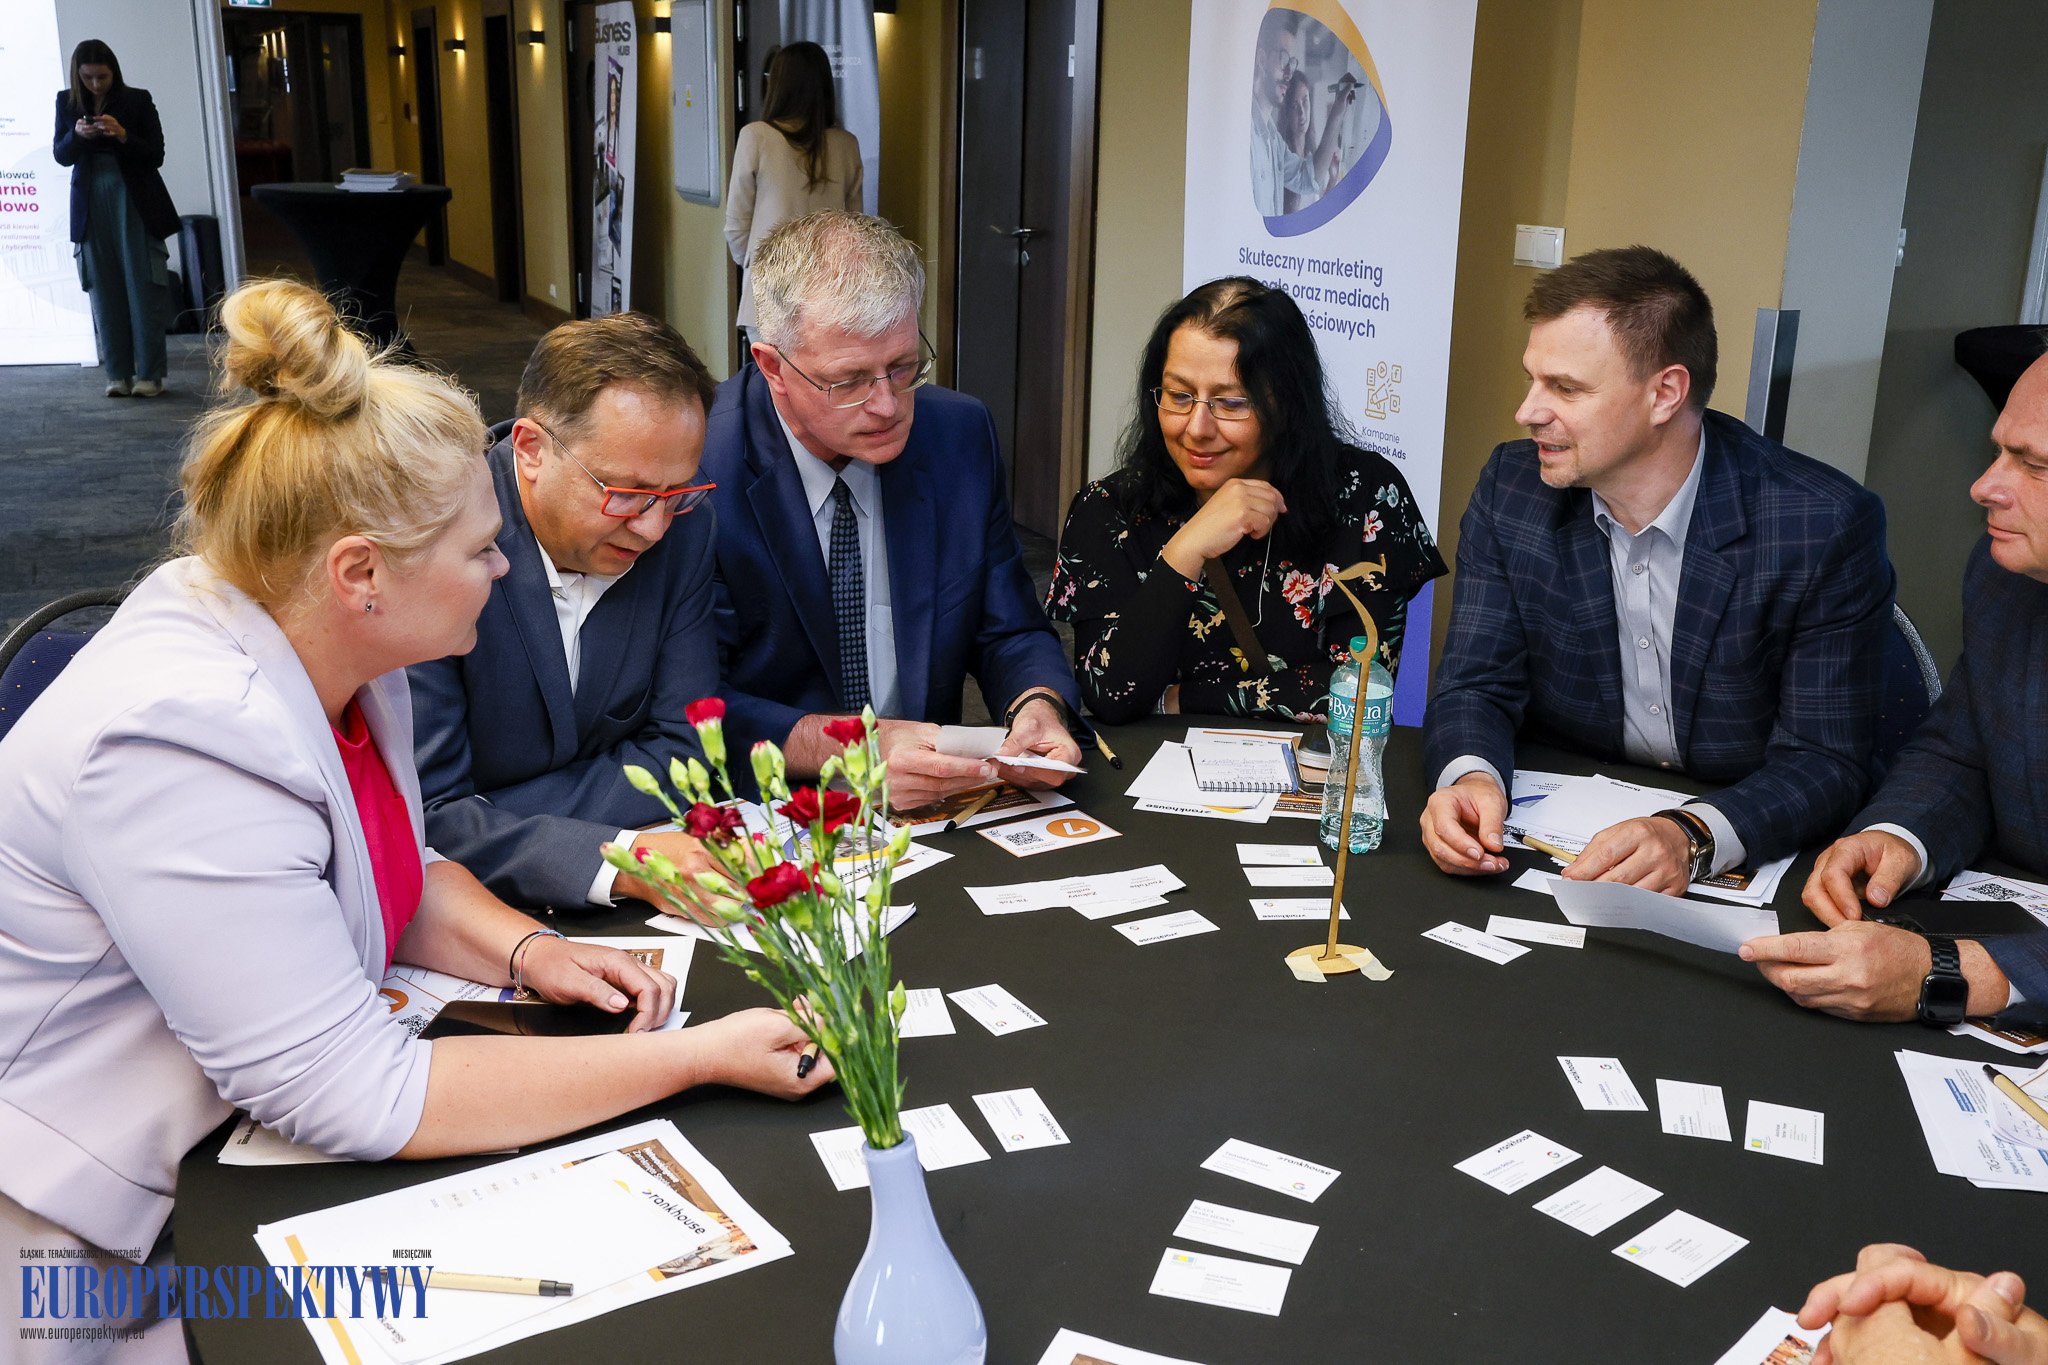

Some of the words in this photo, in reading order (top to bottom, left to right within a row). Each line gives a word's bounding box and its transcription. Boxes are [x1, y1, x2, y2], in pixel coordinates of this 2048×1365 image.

[0, 170, 36, 180] iować
[0, 202, 39, 213] owo
[1239, 247, 1305, 277] Skuteczny
[1307, 257, 1384, 288] marketing
[1292, 284, 1321, 302] oraz
[1324, 288, 1390, 312] mediach
[1361, 426, 1400, 444] Kampanie
[1391, 448, 1407, 460] Ads
[1146, 803, 1202, 814] rankhouse
[1062, 822, 1090, 836] 7
[1281, 1157, 1333, 1175] rankhouse
[650, 1193, 706, 1235] rankhouse
